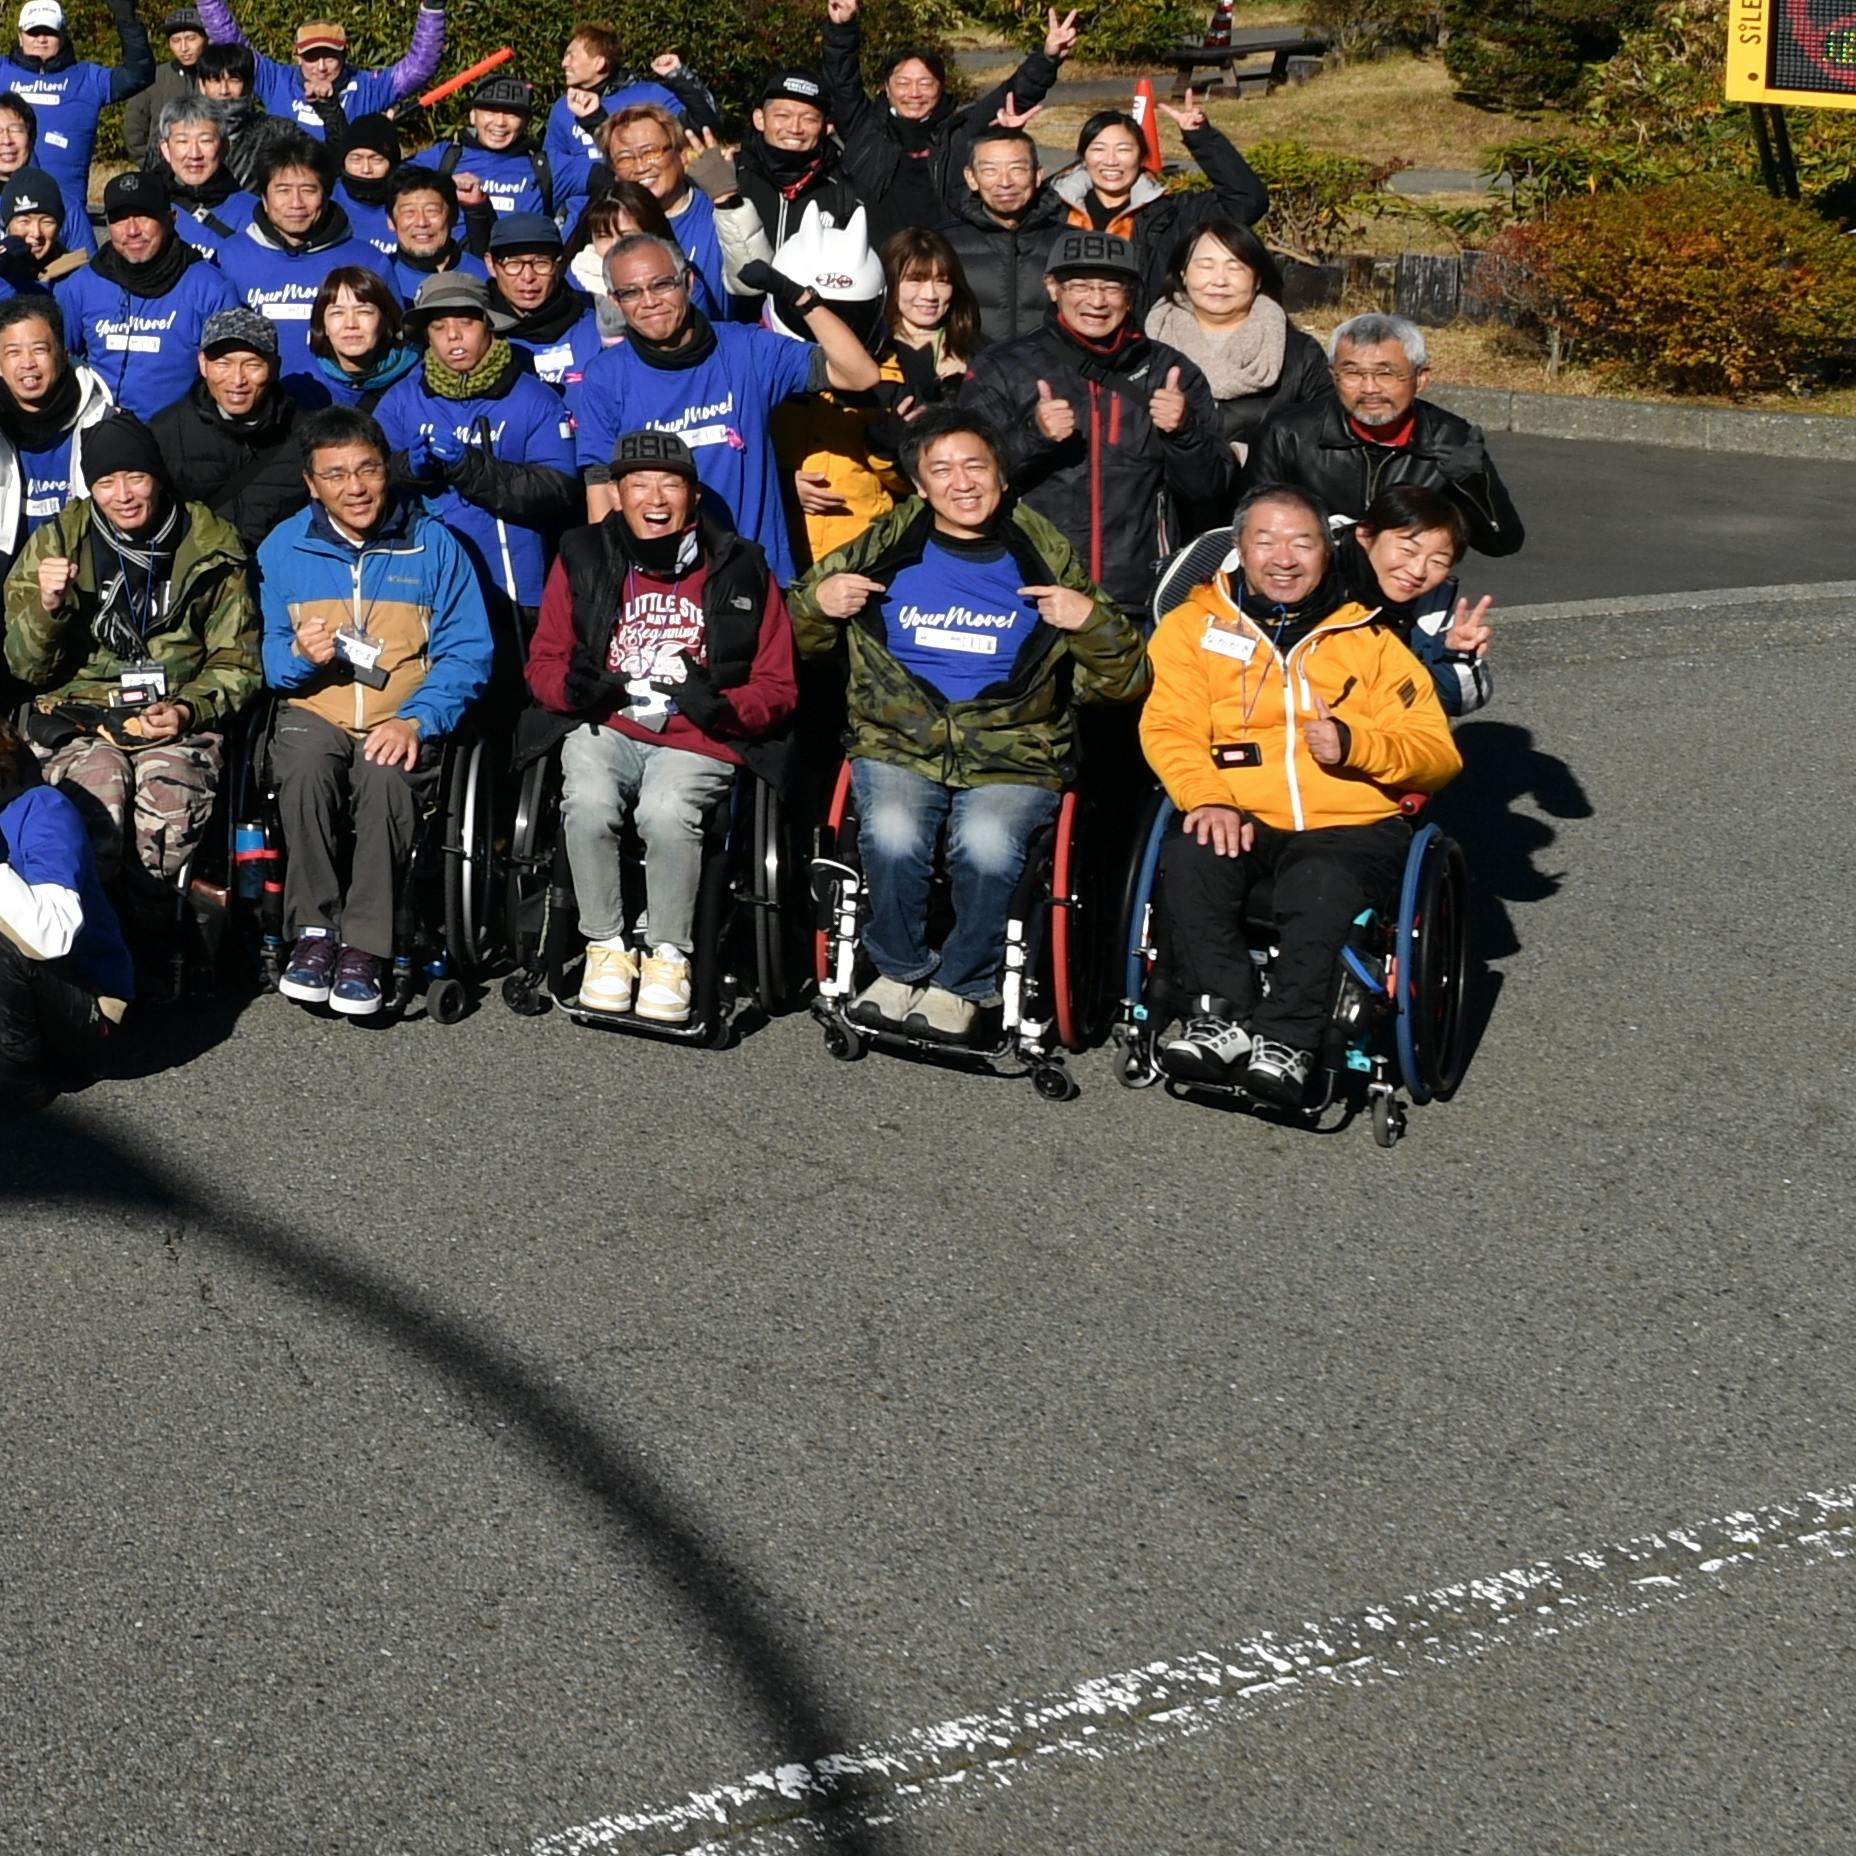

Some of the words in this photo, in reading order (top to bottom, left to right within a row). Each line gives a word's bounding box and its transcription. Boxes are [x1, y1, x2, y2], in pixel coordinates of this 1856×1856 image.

[1063, 237, 1124, 260] SSP
[620, 435, 681, 459] SSP
[625, 592, 677, 621] LITTLE
